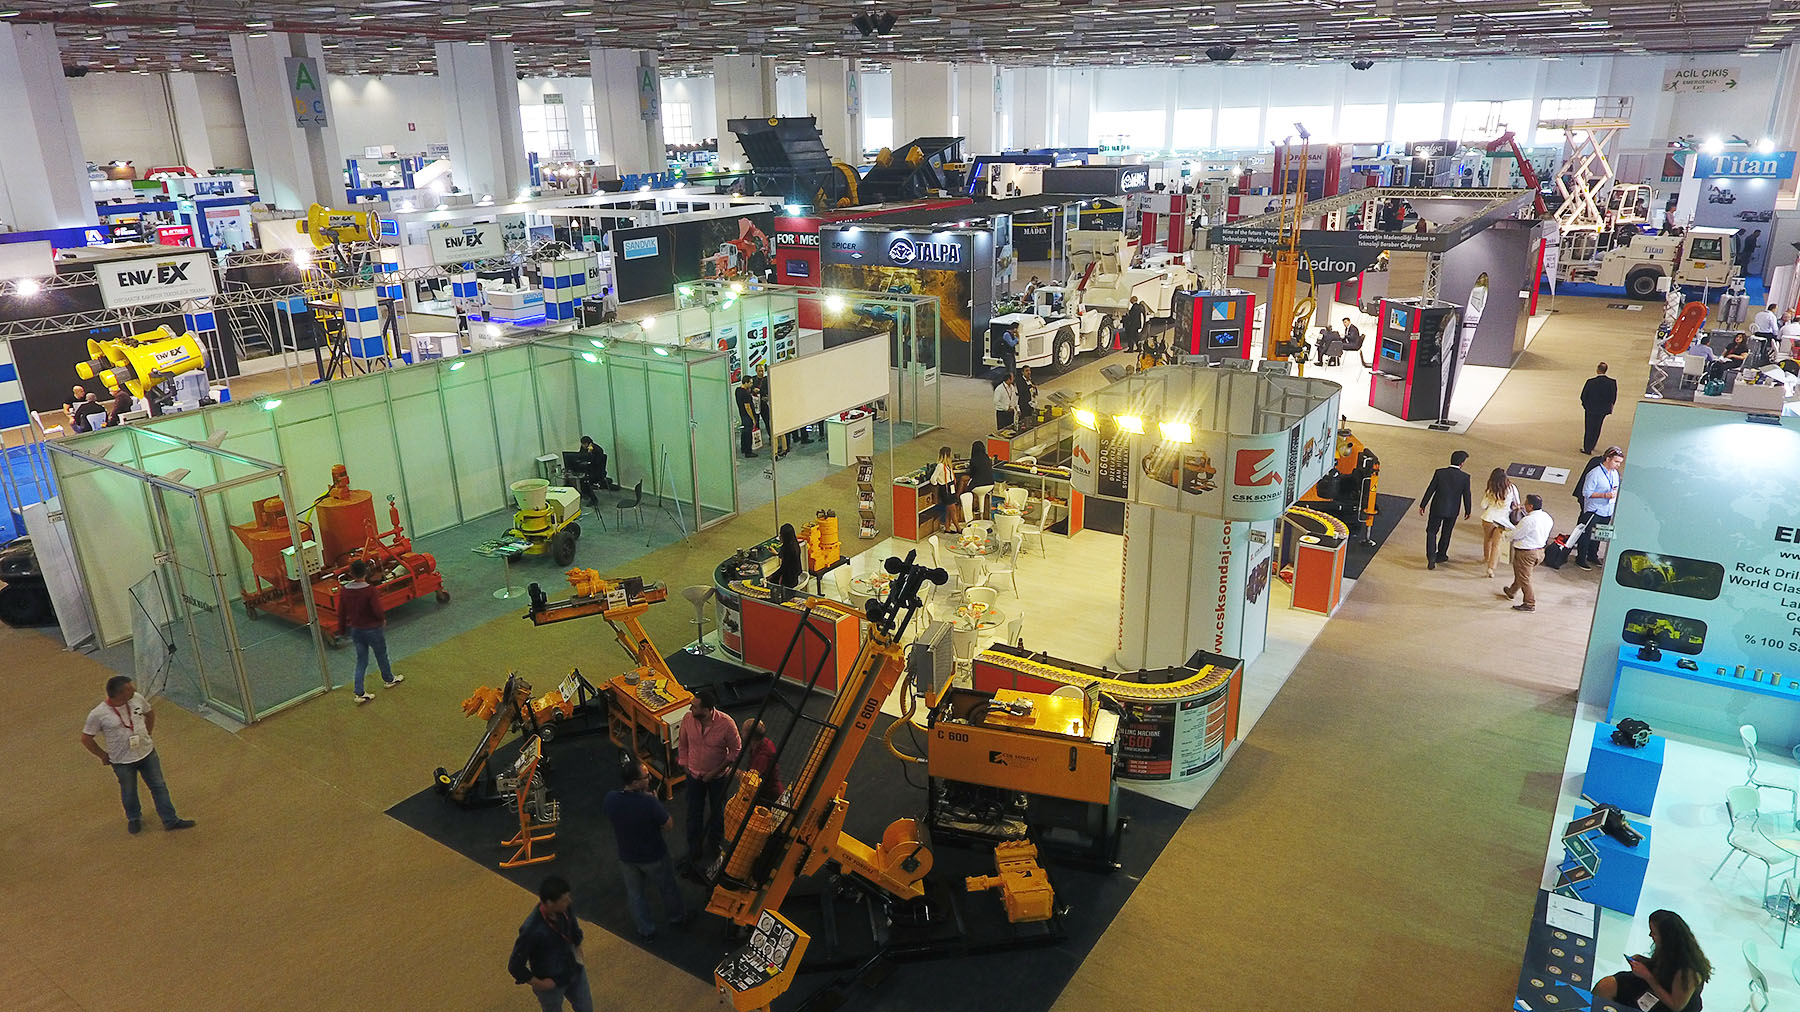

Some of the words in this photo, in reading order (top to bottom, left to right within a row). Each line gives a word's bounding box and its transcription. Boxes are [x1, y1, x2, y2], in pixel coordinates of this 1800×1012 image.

[296, 62, 316, 91] A
[1675, 68, 1698, 78] ACİL
[1702, 68, 1729, 78] ÇIKIŞ
[642, 70, 654, 91] A
[849, 74, 857, 91] A
[1712, 155, 1778, 174] Titan
[624, 239, 656, 250] SANDVIK
[777, 233, 819, 246] FORAMEC
[831, 241, 857, 250] SPICER
[916, 241, 960, 263] TALPA
[1643, 245, 1664, 254] Titan
[1299, 255, 1356, 272] hedron
[1736, 562, 1770, 576] Rock
[1729, 575, 1769, 589] World
[1761, 637, 1784, 649] 100
[855, 721, 866, 730] C
[861, 697, 879, 720] 600
[937, 730, 945, 739] C
[948, 731, 969, 742] 600
